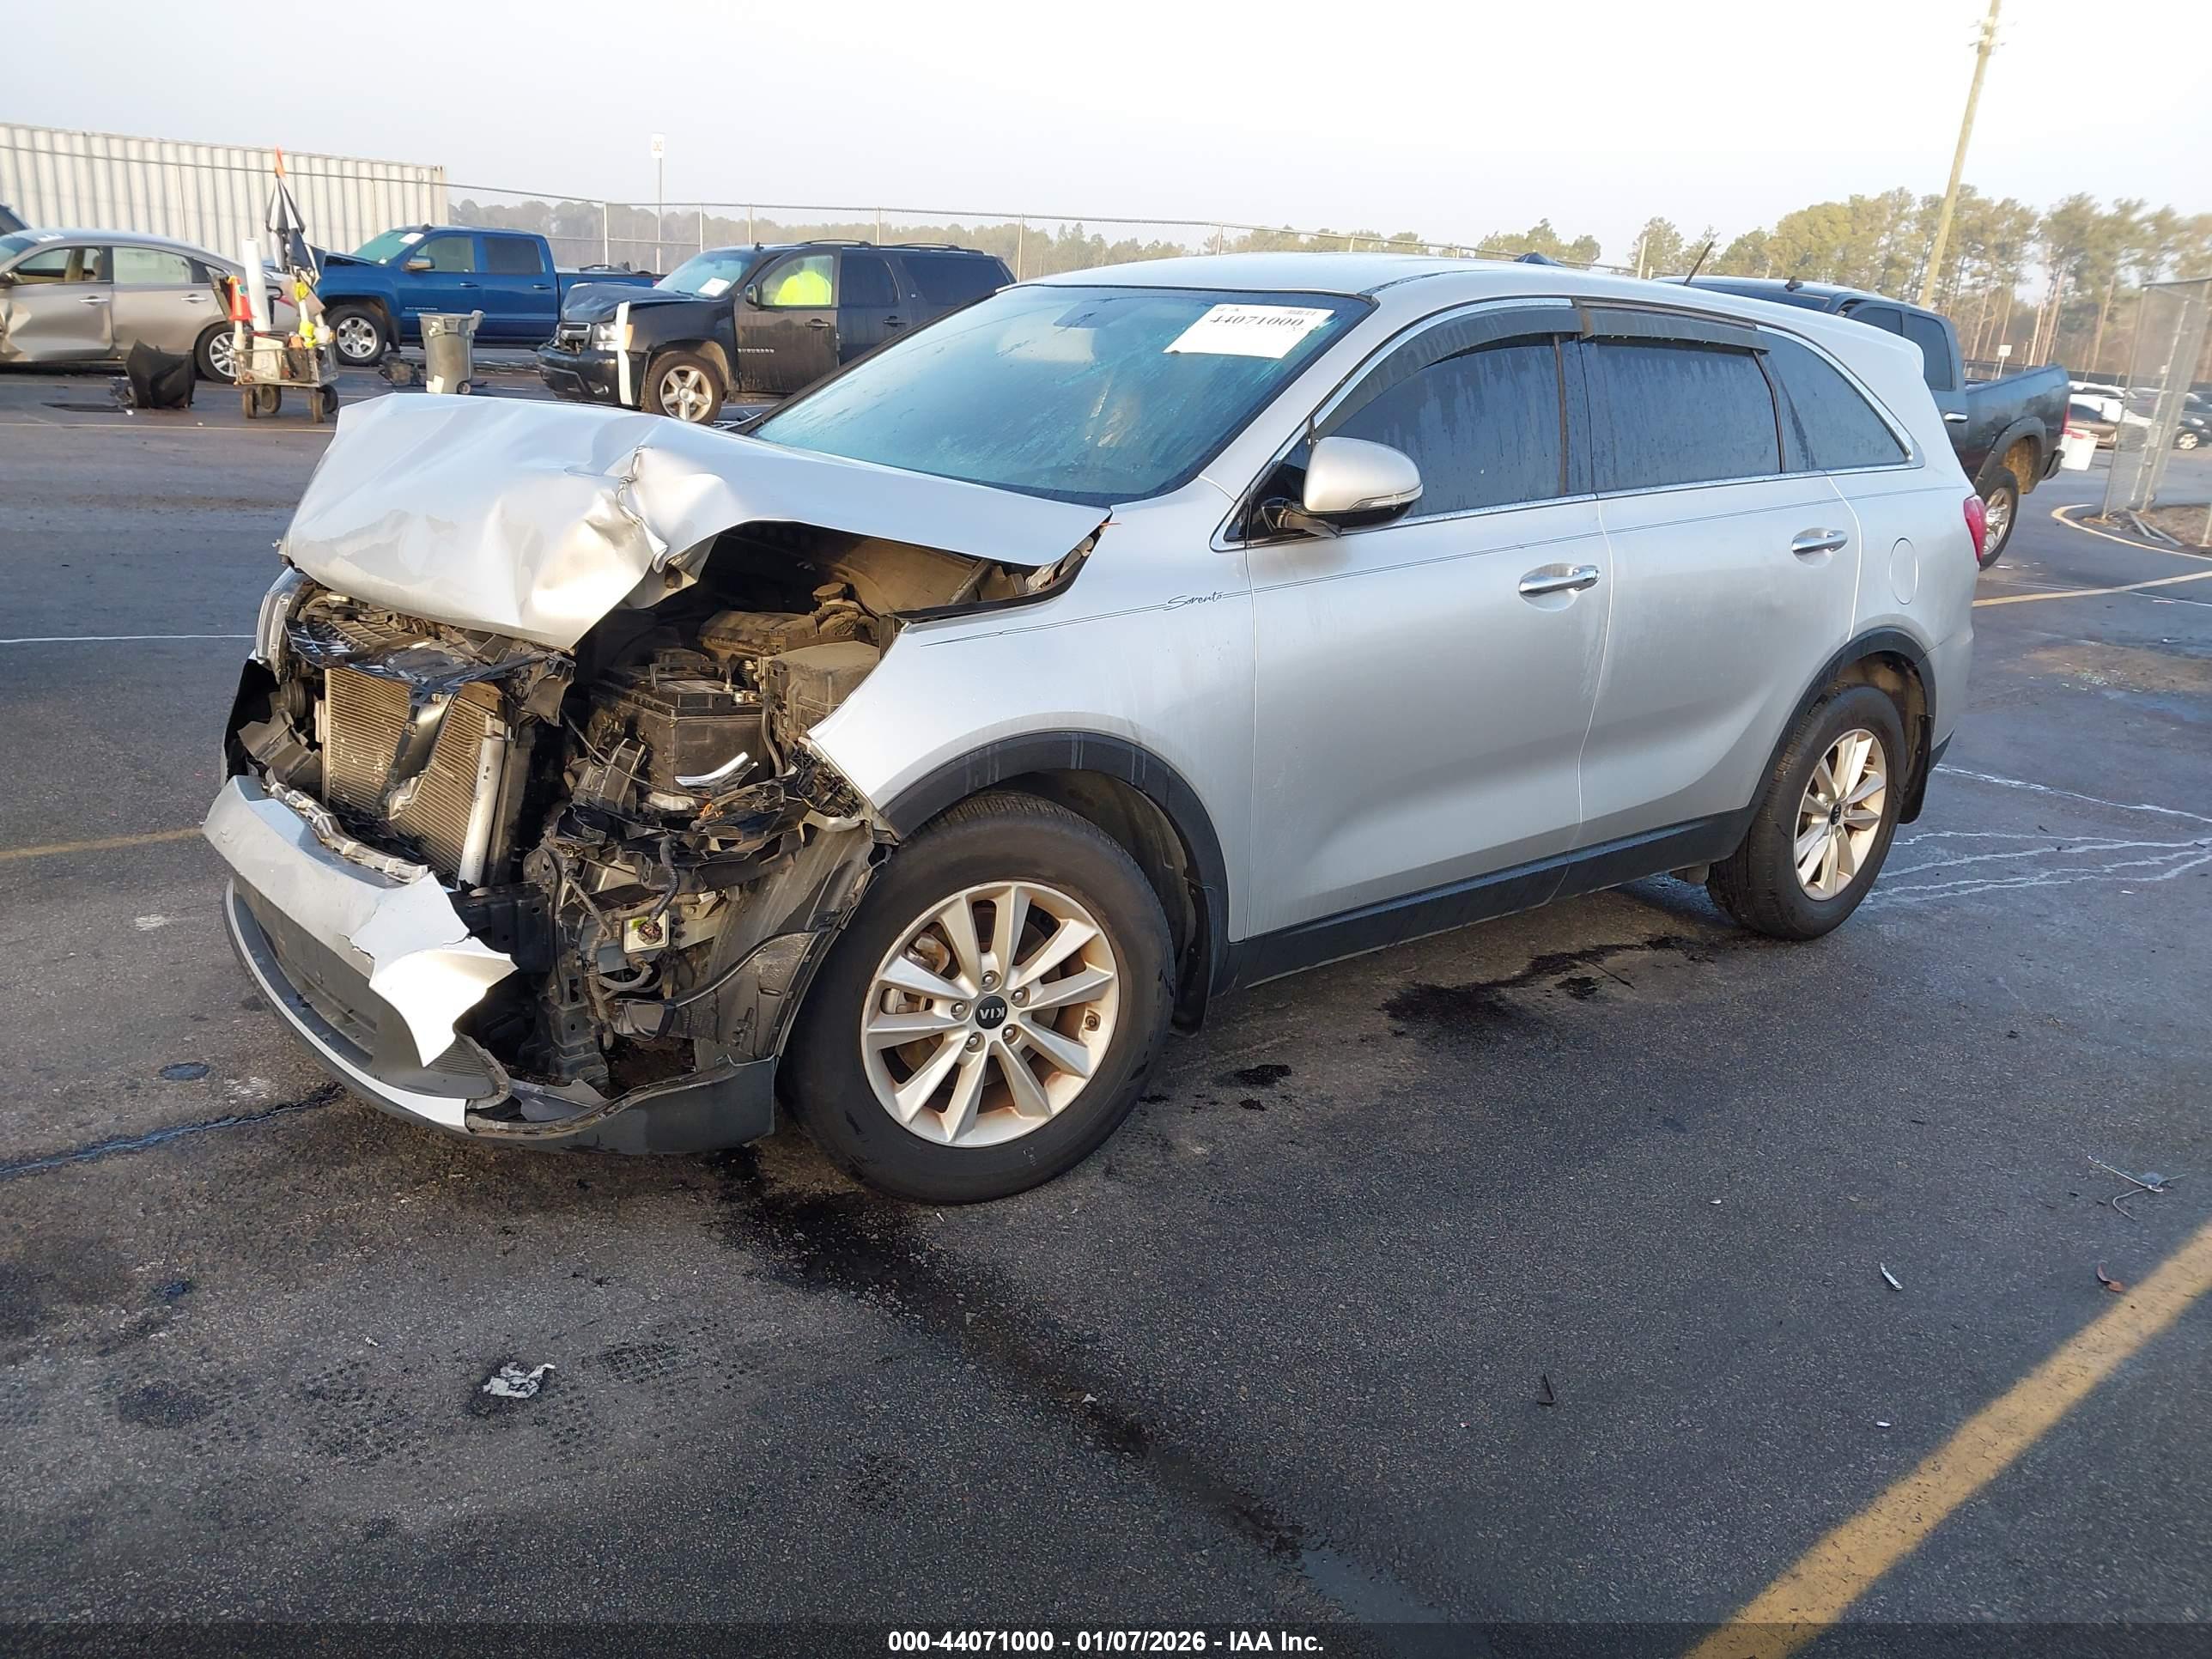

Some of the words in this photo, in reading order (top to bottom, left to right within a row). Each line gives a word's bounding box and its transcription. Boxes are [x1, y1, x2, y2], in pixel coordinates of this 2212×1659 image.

[1210, 315, 1304, 326] 44071000
[1164, 591, 1223, 611] Sorento
[980, 1006, 1006, 1020] KIA
